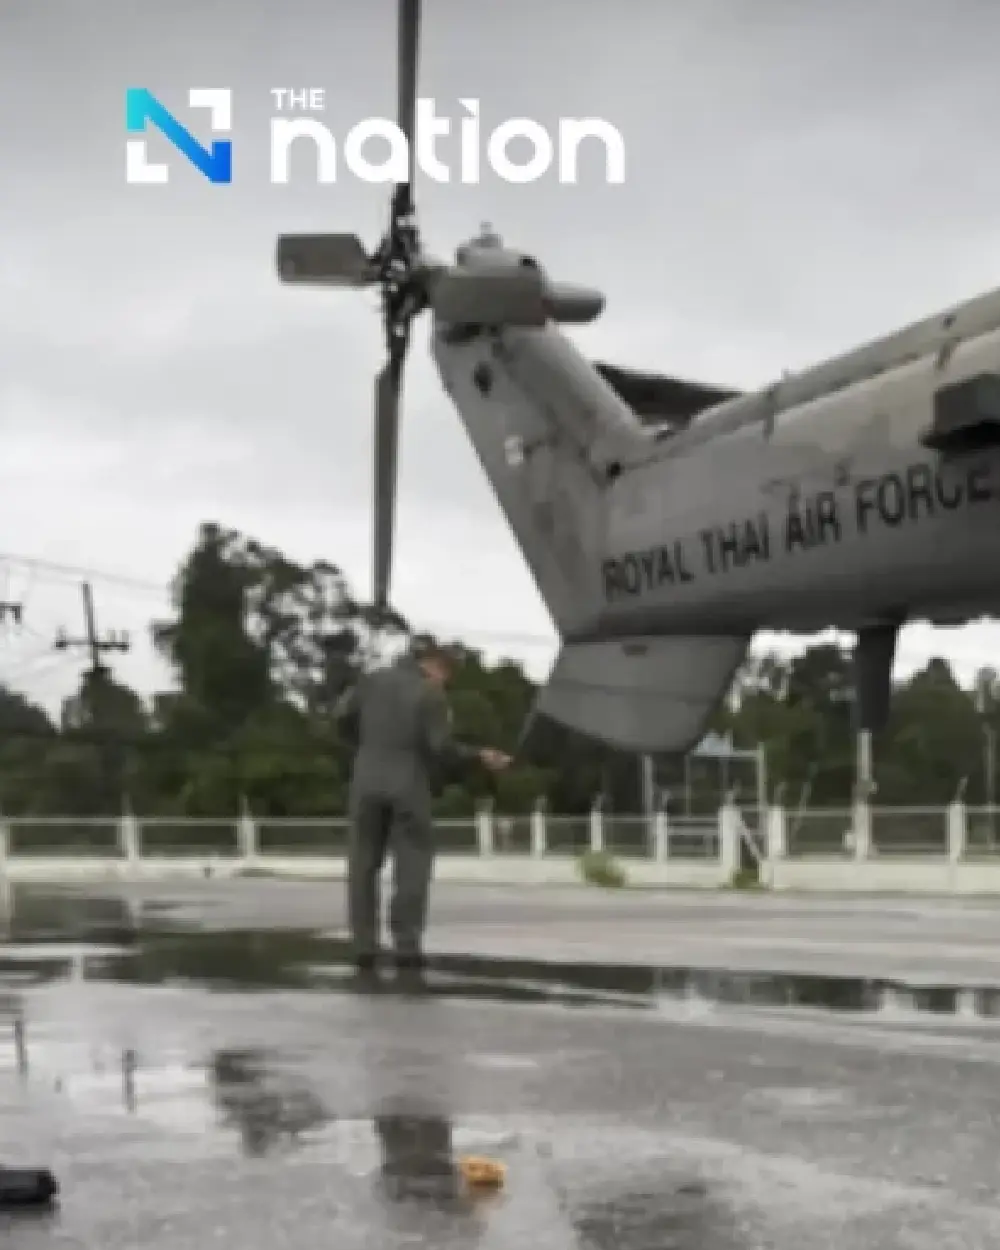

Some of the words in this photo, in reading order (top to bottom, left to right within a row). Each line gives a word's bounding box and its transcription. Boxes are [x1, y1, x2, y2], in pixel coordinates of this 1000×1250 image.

[602, 539, 694, 602] ROYAL
[700, 510, 770, 574] THAI
[783, 491, 843, 552] AIR
